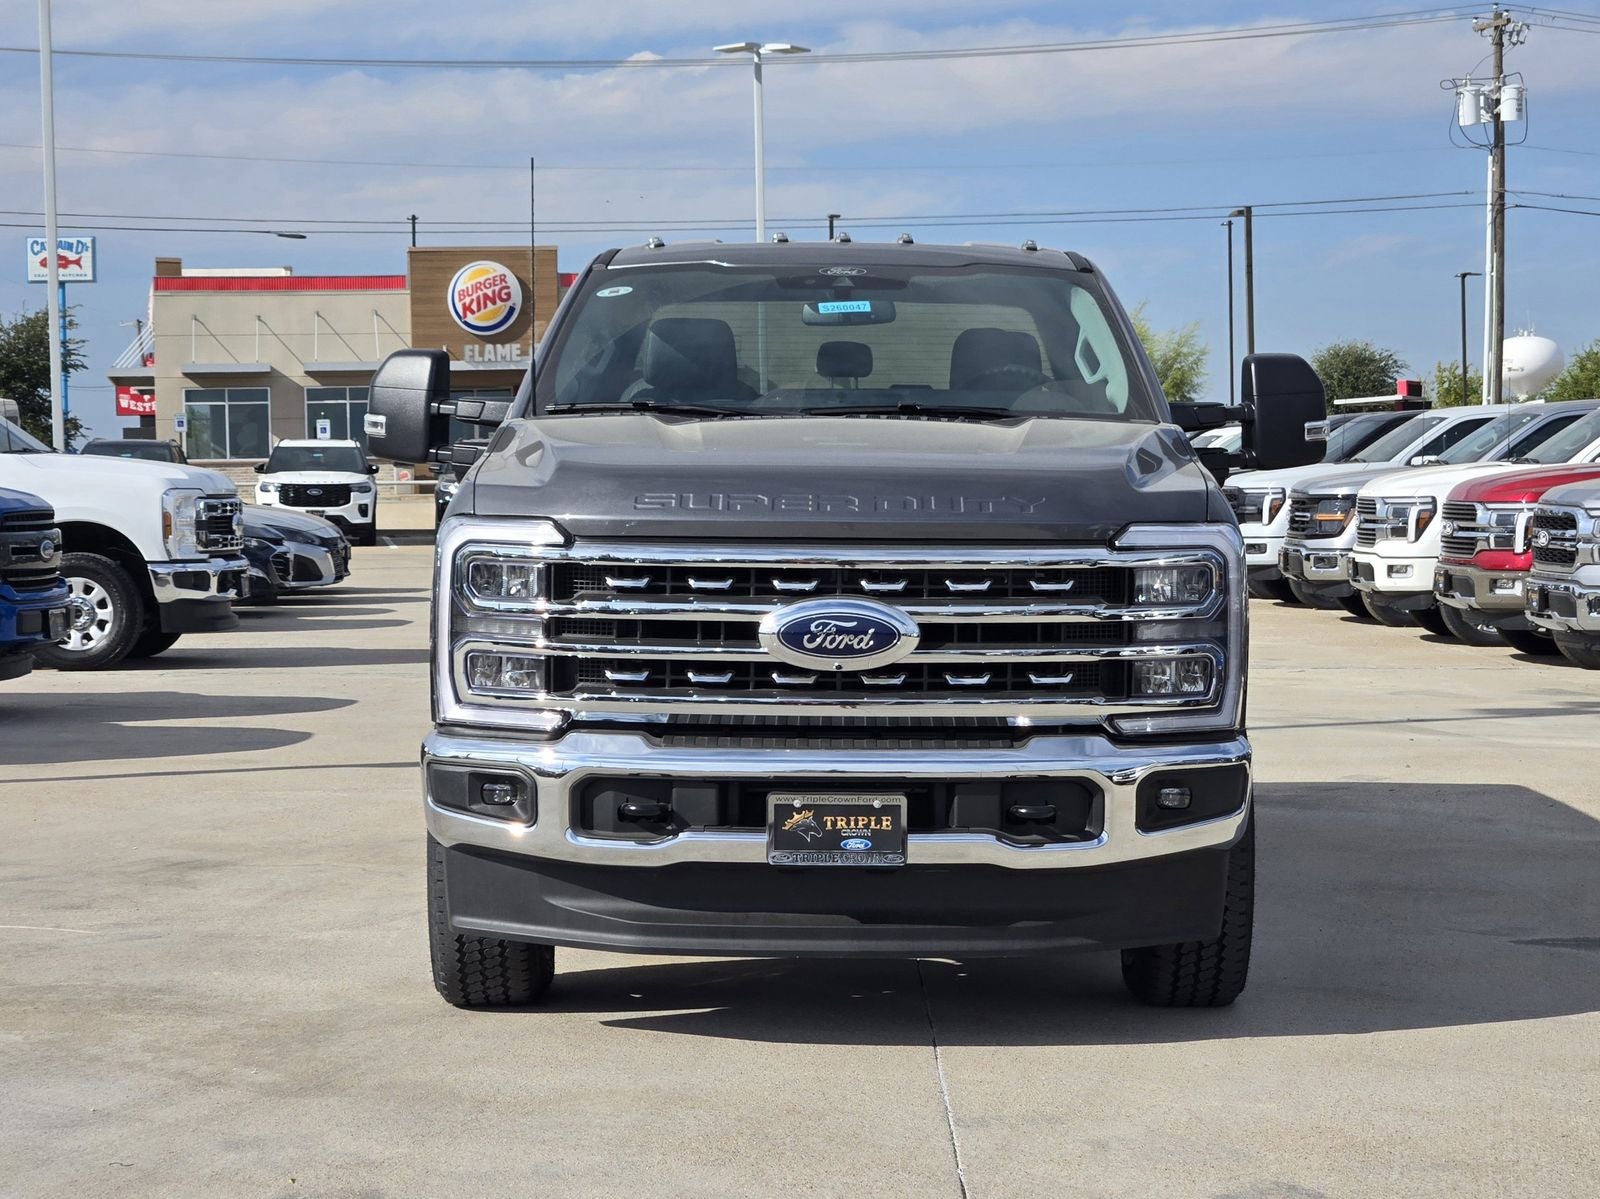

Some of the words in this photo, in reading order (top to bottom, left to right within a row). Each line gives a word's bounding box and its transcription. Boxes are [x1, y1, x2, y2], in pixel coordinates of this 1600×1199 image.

[457, 273, 508, 302] BURGER
[461, 285, 512, 320] KING
[821, 303, 868, 312] S260047
[463, 344, 521, 362] FLAME
[633, 493, 858, 511] SUPER
[873, 495, 1047, 514] DUTY
[803, 619, 875, 650] Ford
[823, 816, 893, 831] TRIPLE
[840, 829, 872, 837] CROWN
[792, 853, 840, 863] TRIPLE
